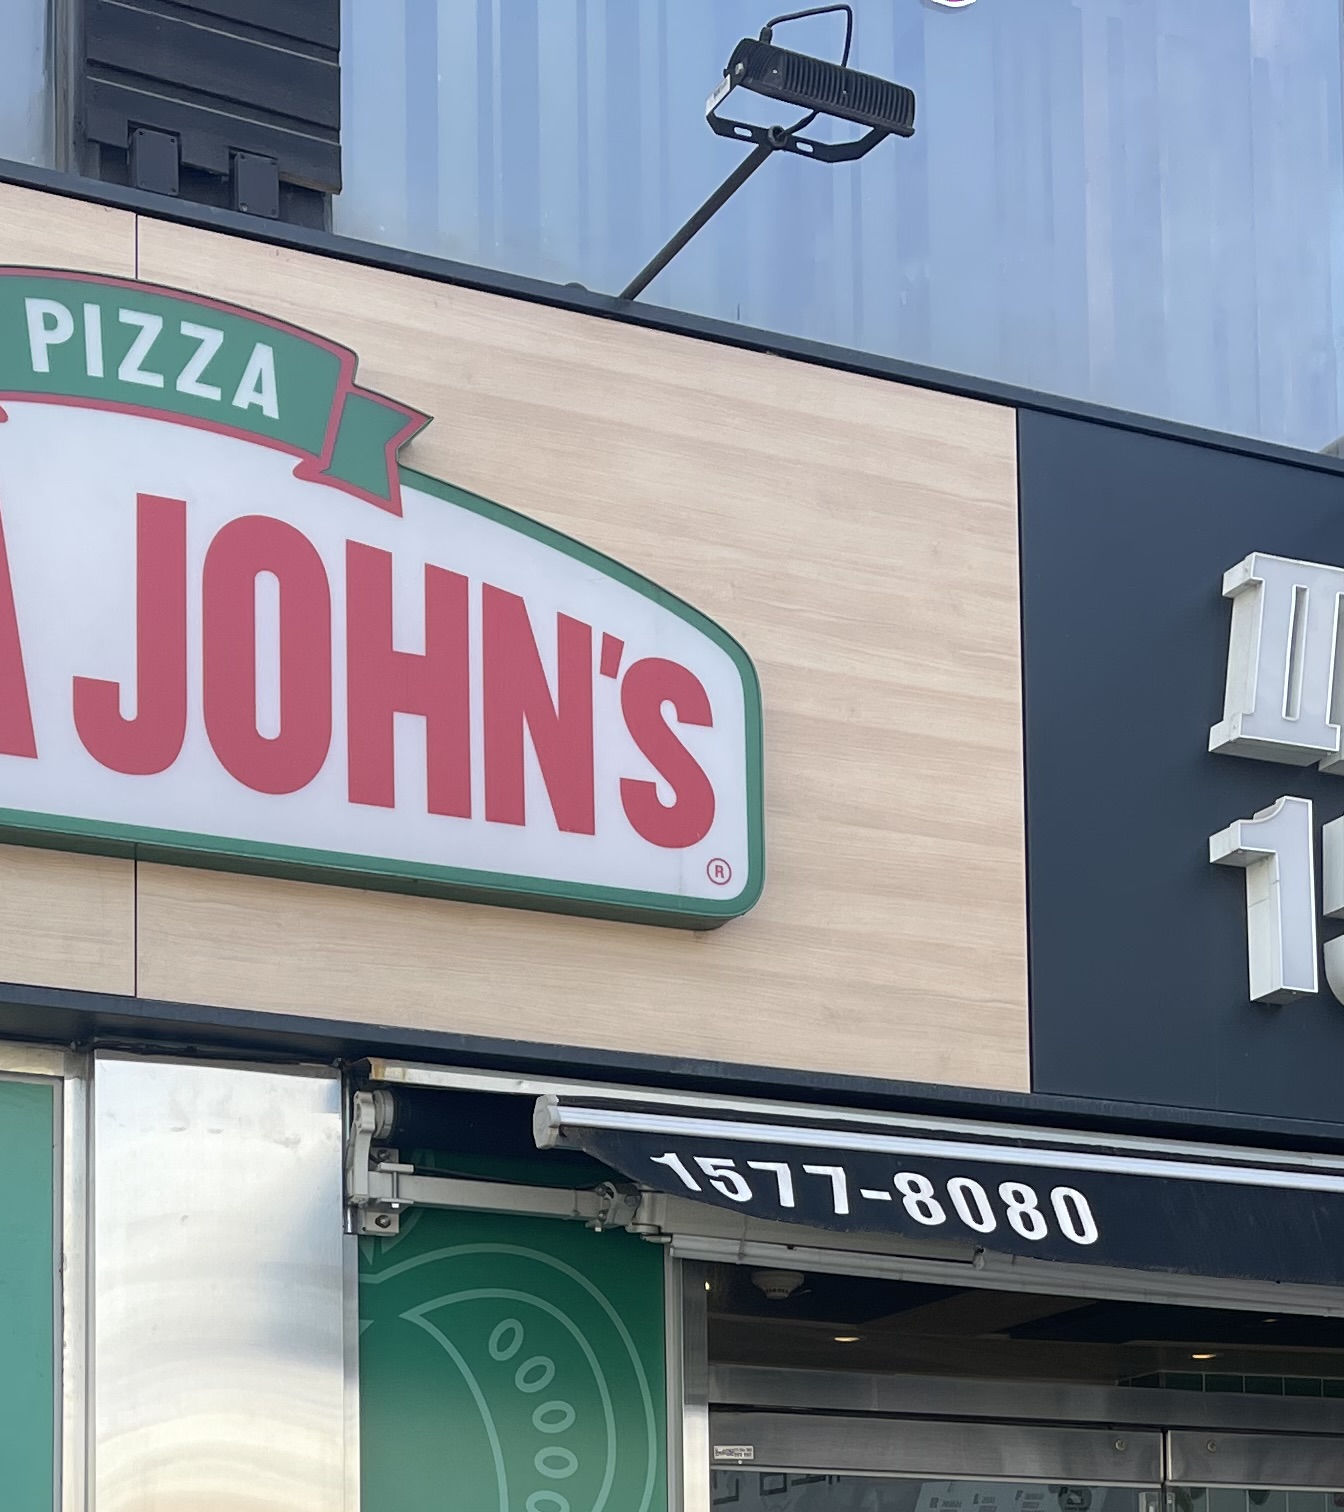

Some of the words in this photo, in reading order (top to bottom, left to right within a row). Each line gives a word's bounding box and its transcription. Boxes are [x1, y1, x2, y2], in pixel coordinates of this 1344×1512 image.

[24, 296, 282, 420] PIZZA
[72, 491, 716, 850] JOHN'S
[650, 1151, 1099, 1247] 1577-8080
